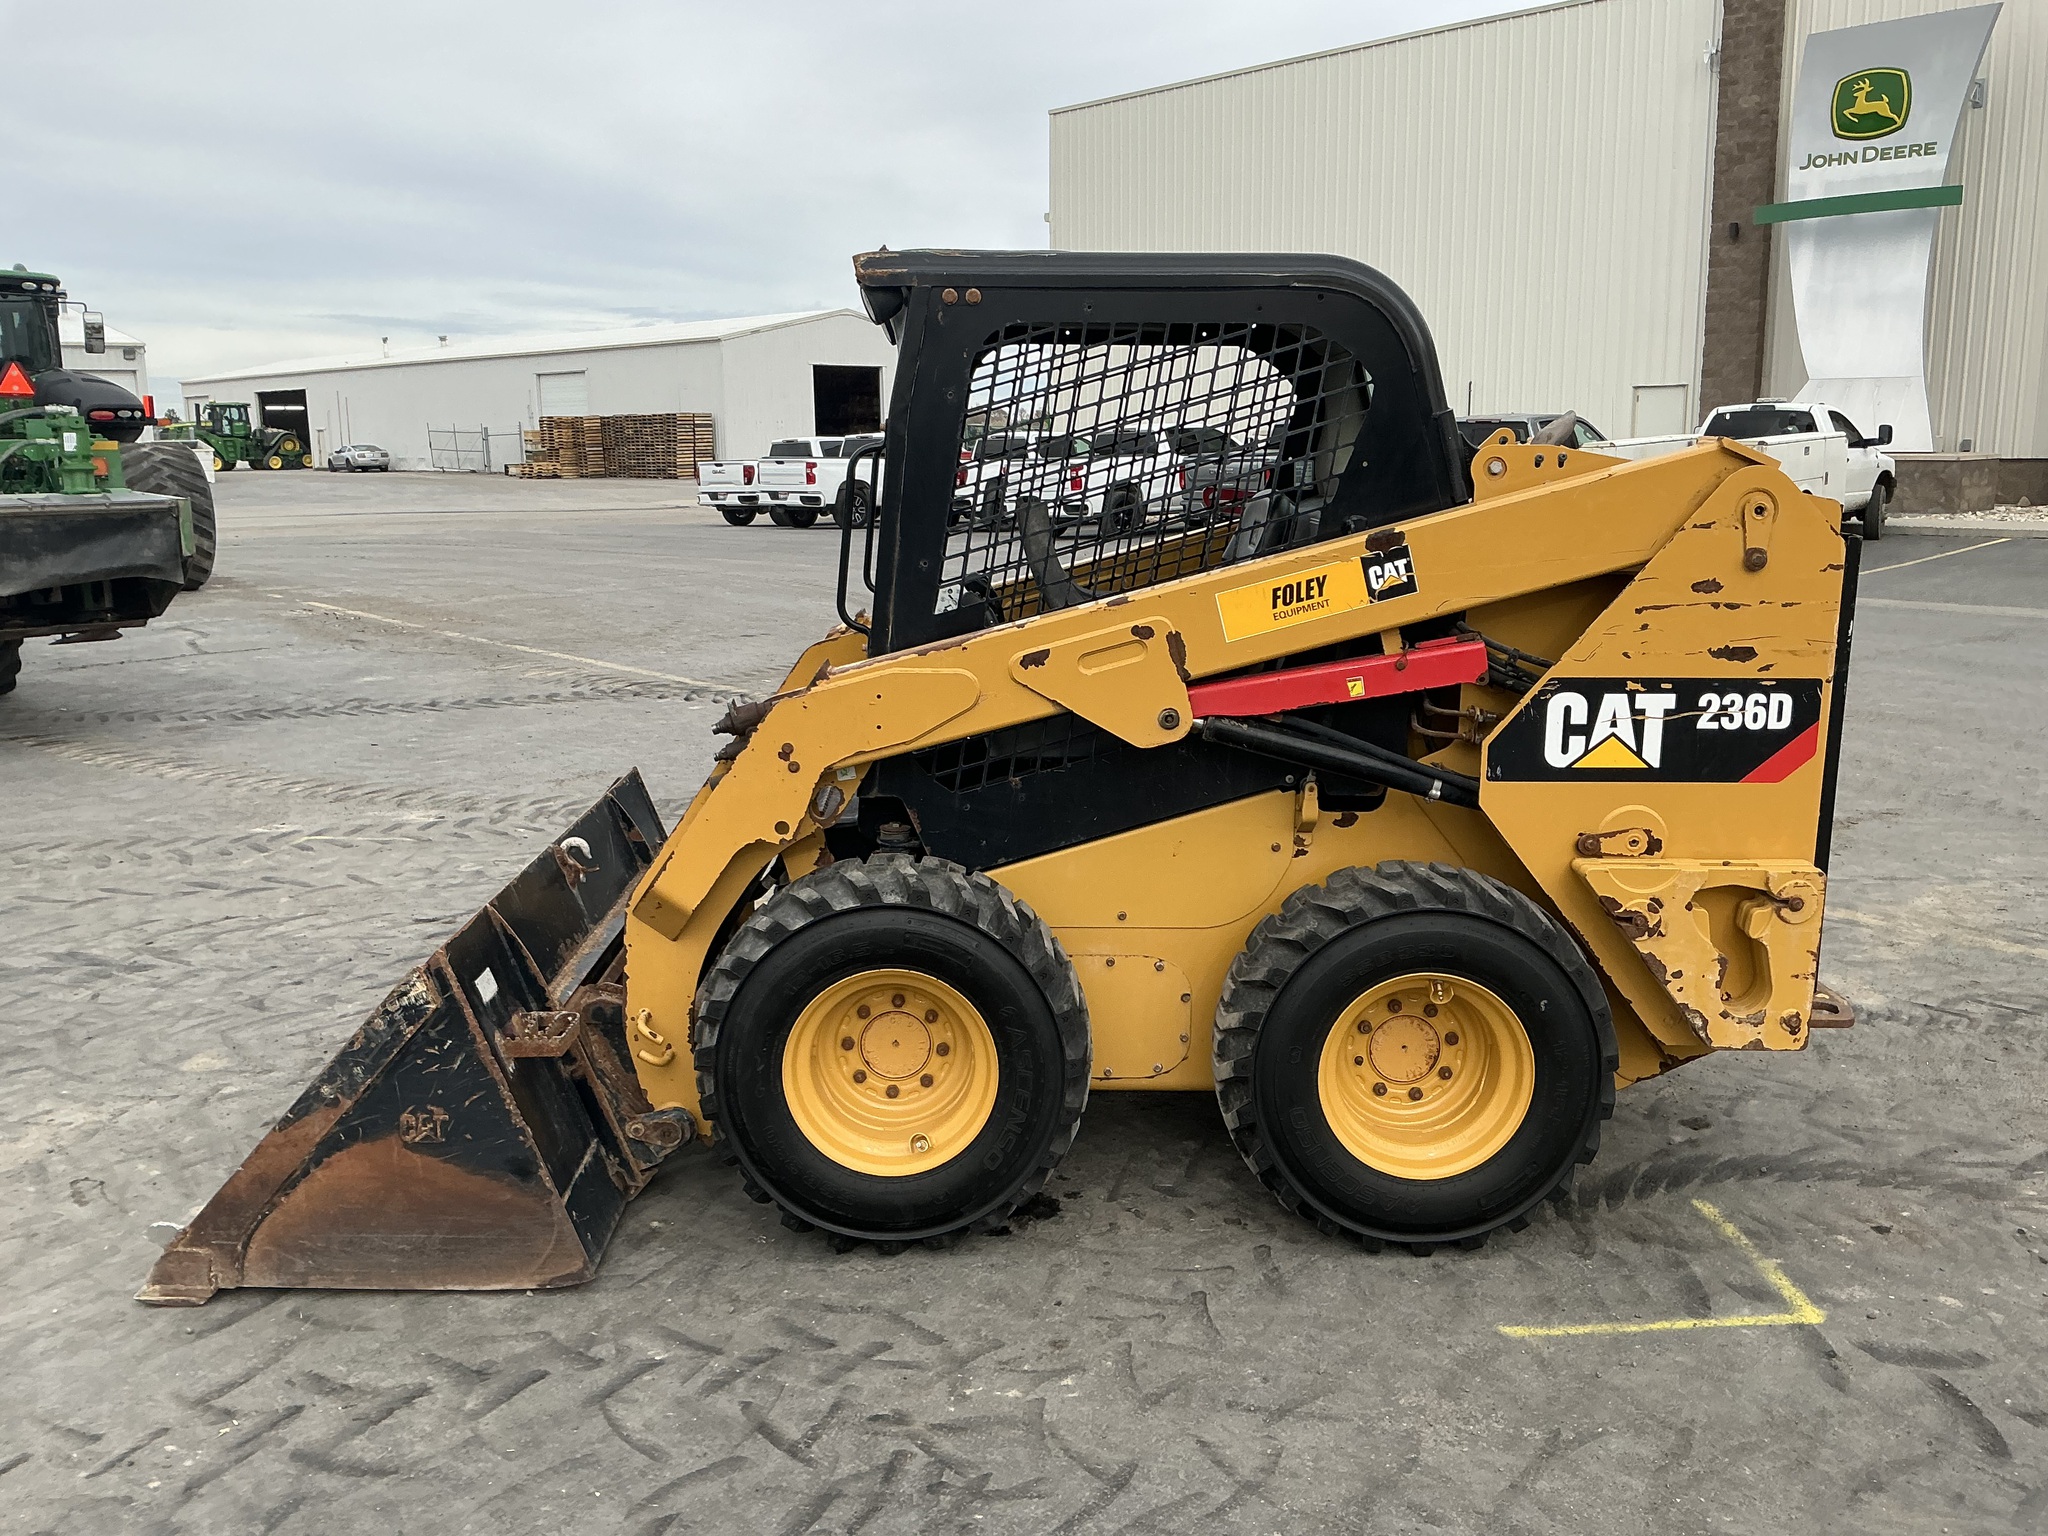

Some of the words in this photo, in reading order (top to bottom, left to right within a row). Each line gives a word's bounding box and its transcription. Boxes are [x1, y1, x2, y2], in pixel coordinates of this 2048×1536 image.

[1799, 149, 1858, 170] JOHN
[1862, 141, 1938, 162] DEERE
[1367, 557, 1409, 591] CAT
[1271, 574, 1328, 610] FOLEY
[1273, 598, 1330, 621] EQUIPMENT
[1543, 691, 1677, 769] CAT
[1696, 692, 1794, 731] 236D
[984, 1026, 1032, 1171] ASCENSO
